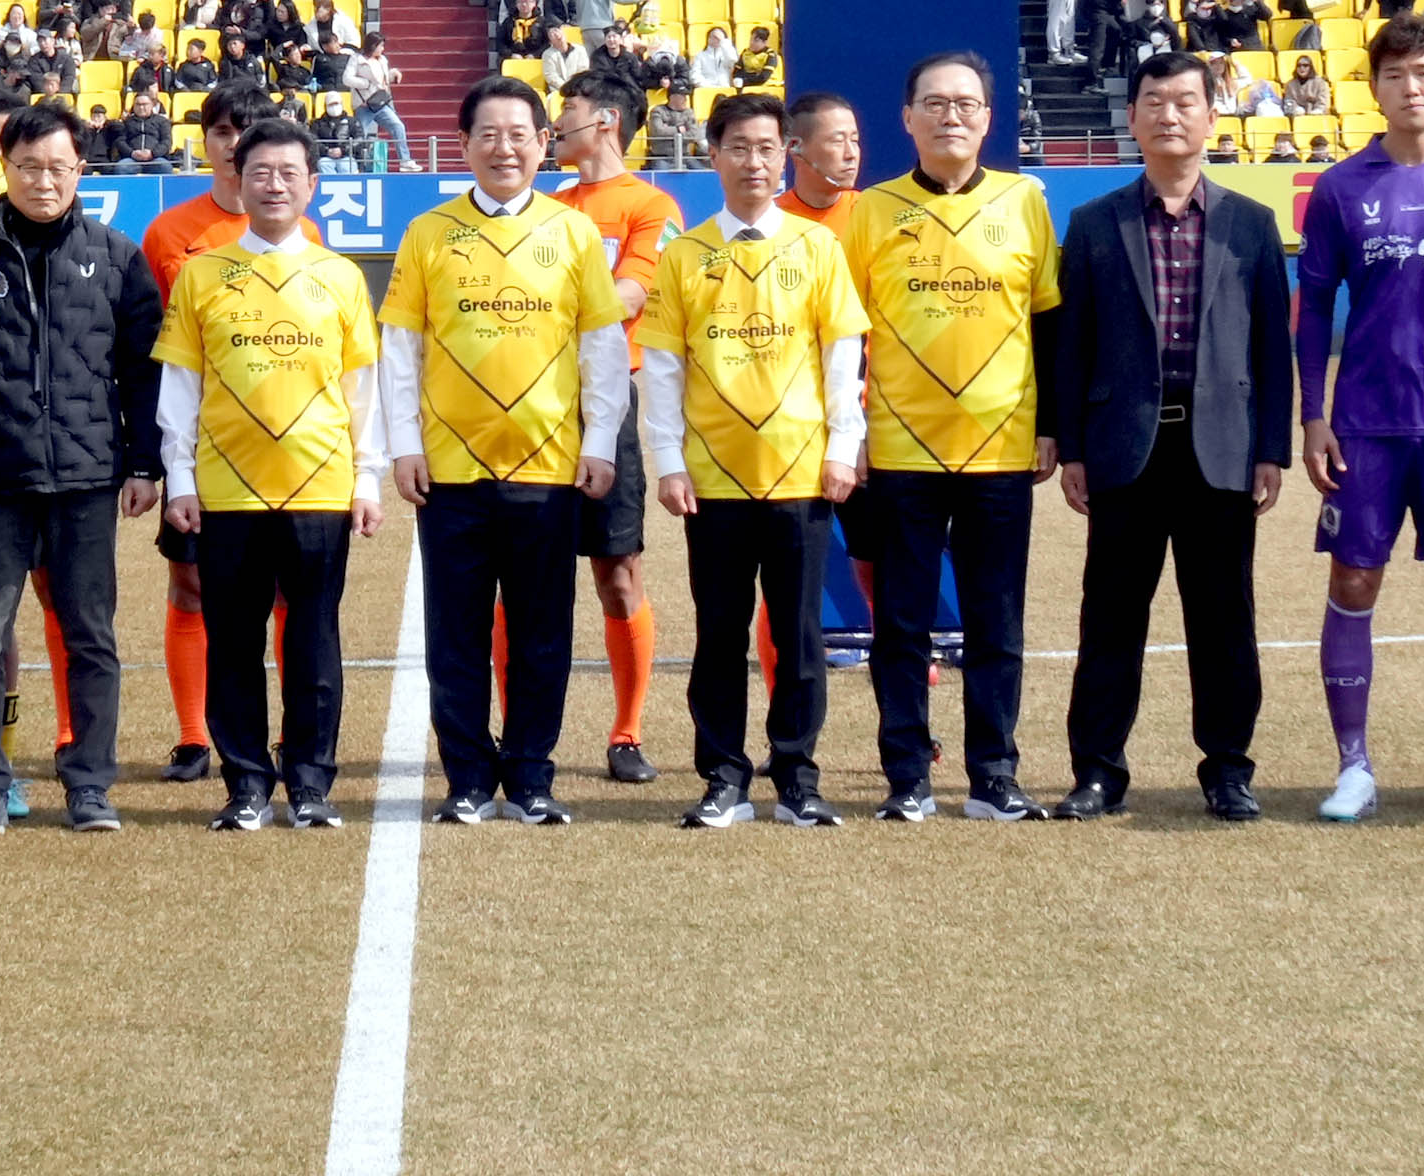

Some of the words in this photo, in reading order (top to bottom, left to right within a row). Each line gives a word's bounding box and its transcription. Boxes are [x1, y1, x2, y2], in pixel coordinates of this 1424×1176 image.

[908, 255, 942, 267] 포스코
[457, 275, 491, 288] 포스코
[908, 277, 1002, 293] Greenable
[458, 296, 553, 313] Greenable
[229, 310, 263, 323] 포스코
[230, 326, 324, 348] Greenable
[707, 322, 795, 339] Greenable
